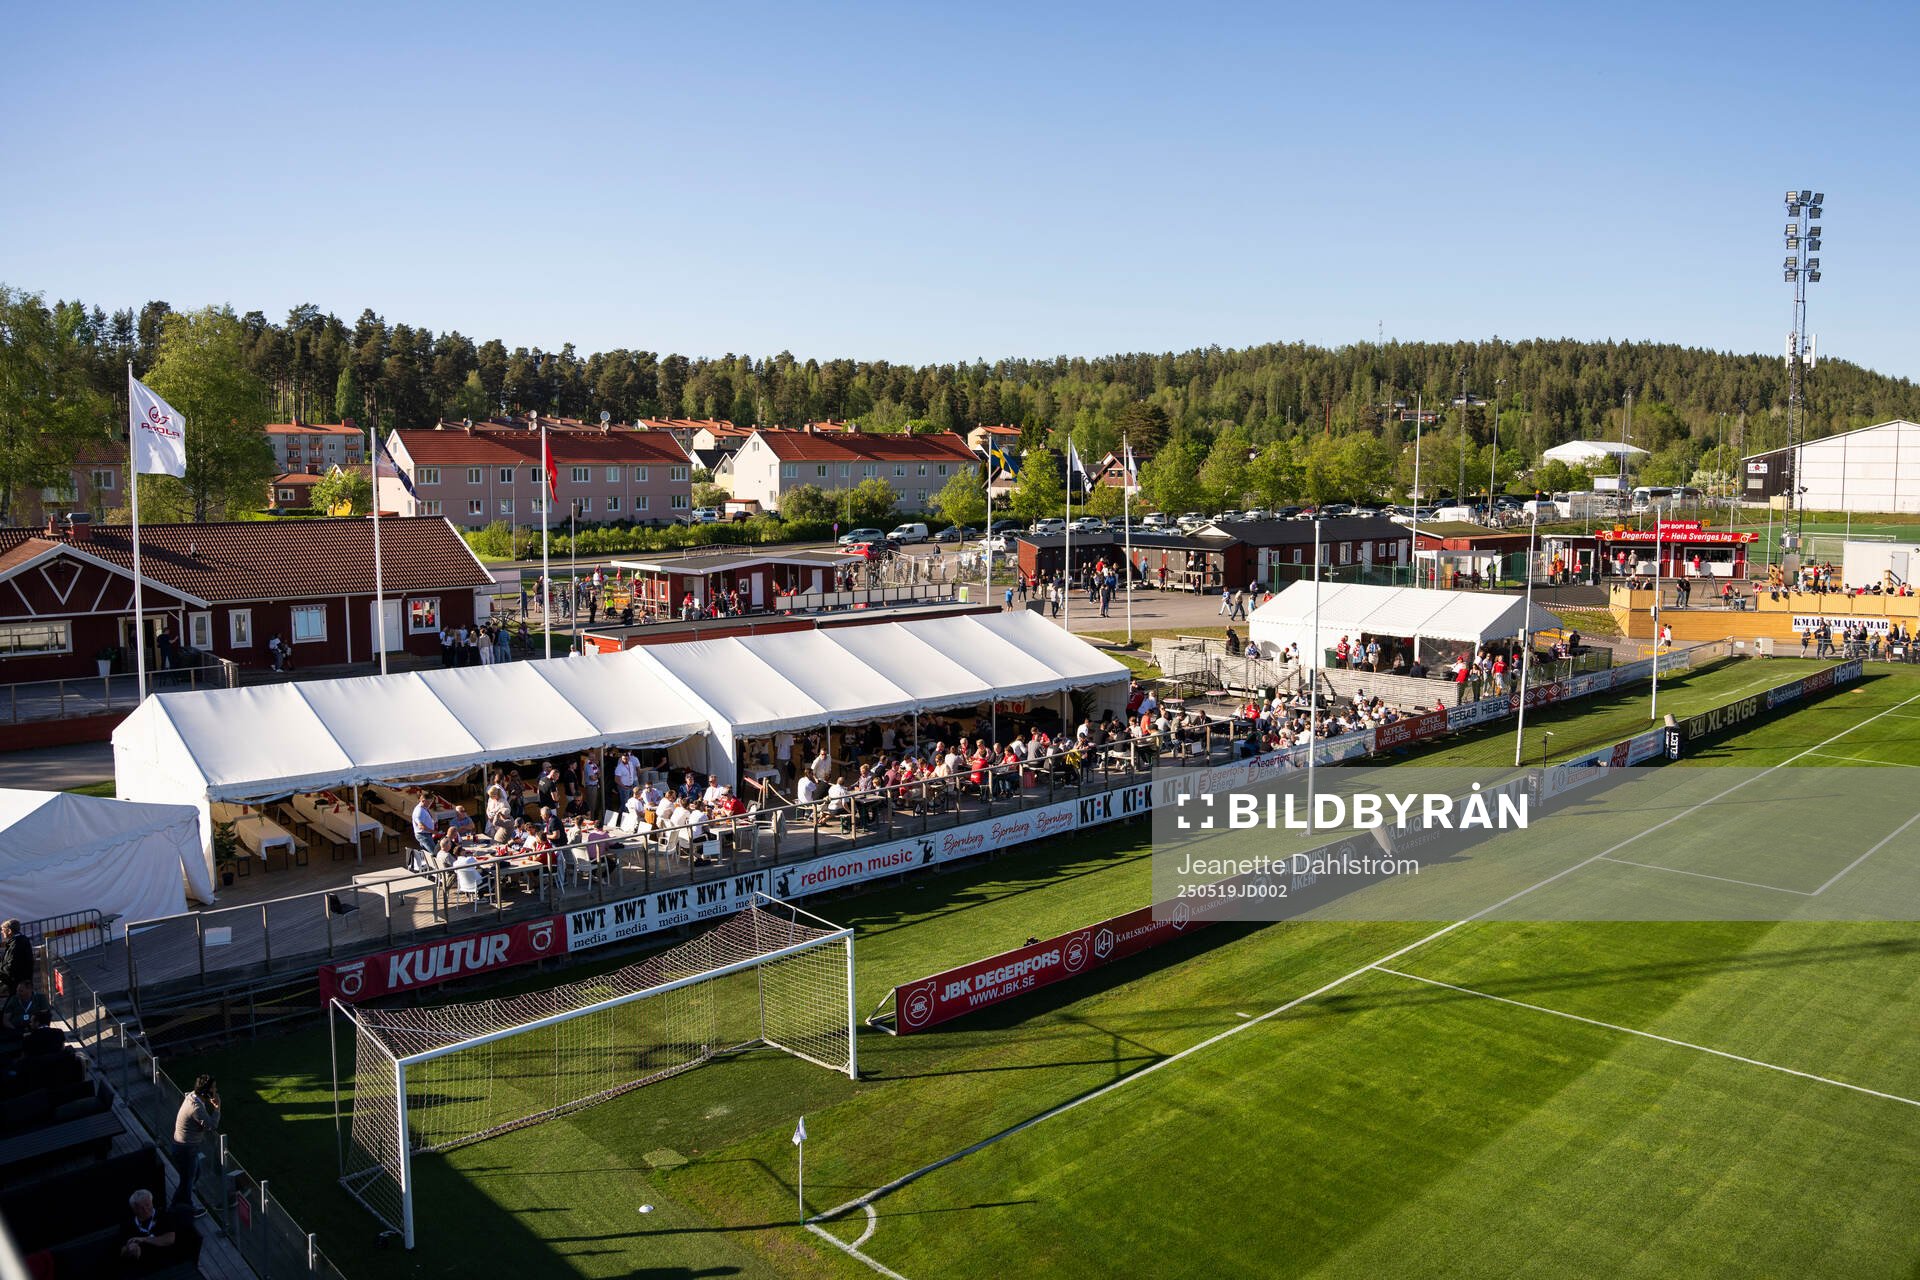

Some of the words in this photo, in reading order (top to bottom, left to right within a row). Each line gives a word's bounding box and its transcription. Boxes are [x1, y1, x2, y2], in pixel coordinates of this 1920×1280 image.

[1621, 531, 1656, 541] Degerfors
[1671, 532, 1687, 541] Hela
[1689, 532, 1719, 542] Sveriges
[1721, 534, 1732, 542] lag
[1420, 714, 1442, 727] NORDIC
[1707, 697, 1758, 733] XL-BYGG
[1379, 730, 1411, 747] WELLNESS
[1383, 723, 1406, 737] NORDIC
[1415, 721, 1446, 737] WELLNESS
[1670, 731, 1679, 760] SELECT
[801, 862, 863, 886] redhorn
[867, 848, 913, 872] music
[697, 881, 727, 905] NWT
[735, 873, 764, 896] NWT
[614, 898, 647, 925] NWT
[657, 889, 688, 914] NWT
[697, 903, 728, 919] media
[573, 908, 606, 935] NWT
[615, 923, 648, 938] media
[658, 913, 689, 928] media
[1115, 917, 1171, 944] KARLSKOGAHEM
[573, 932, 608, 949] media
[387, 934, 511, 989] KULTUR
[941, 976, 973, 1002] JBK
[975, 949, 1061, 991] DEGERFORS
[969, 975, 1035, 1007] WWW.JBK.SE
